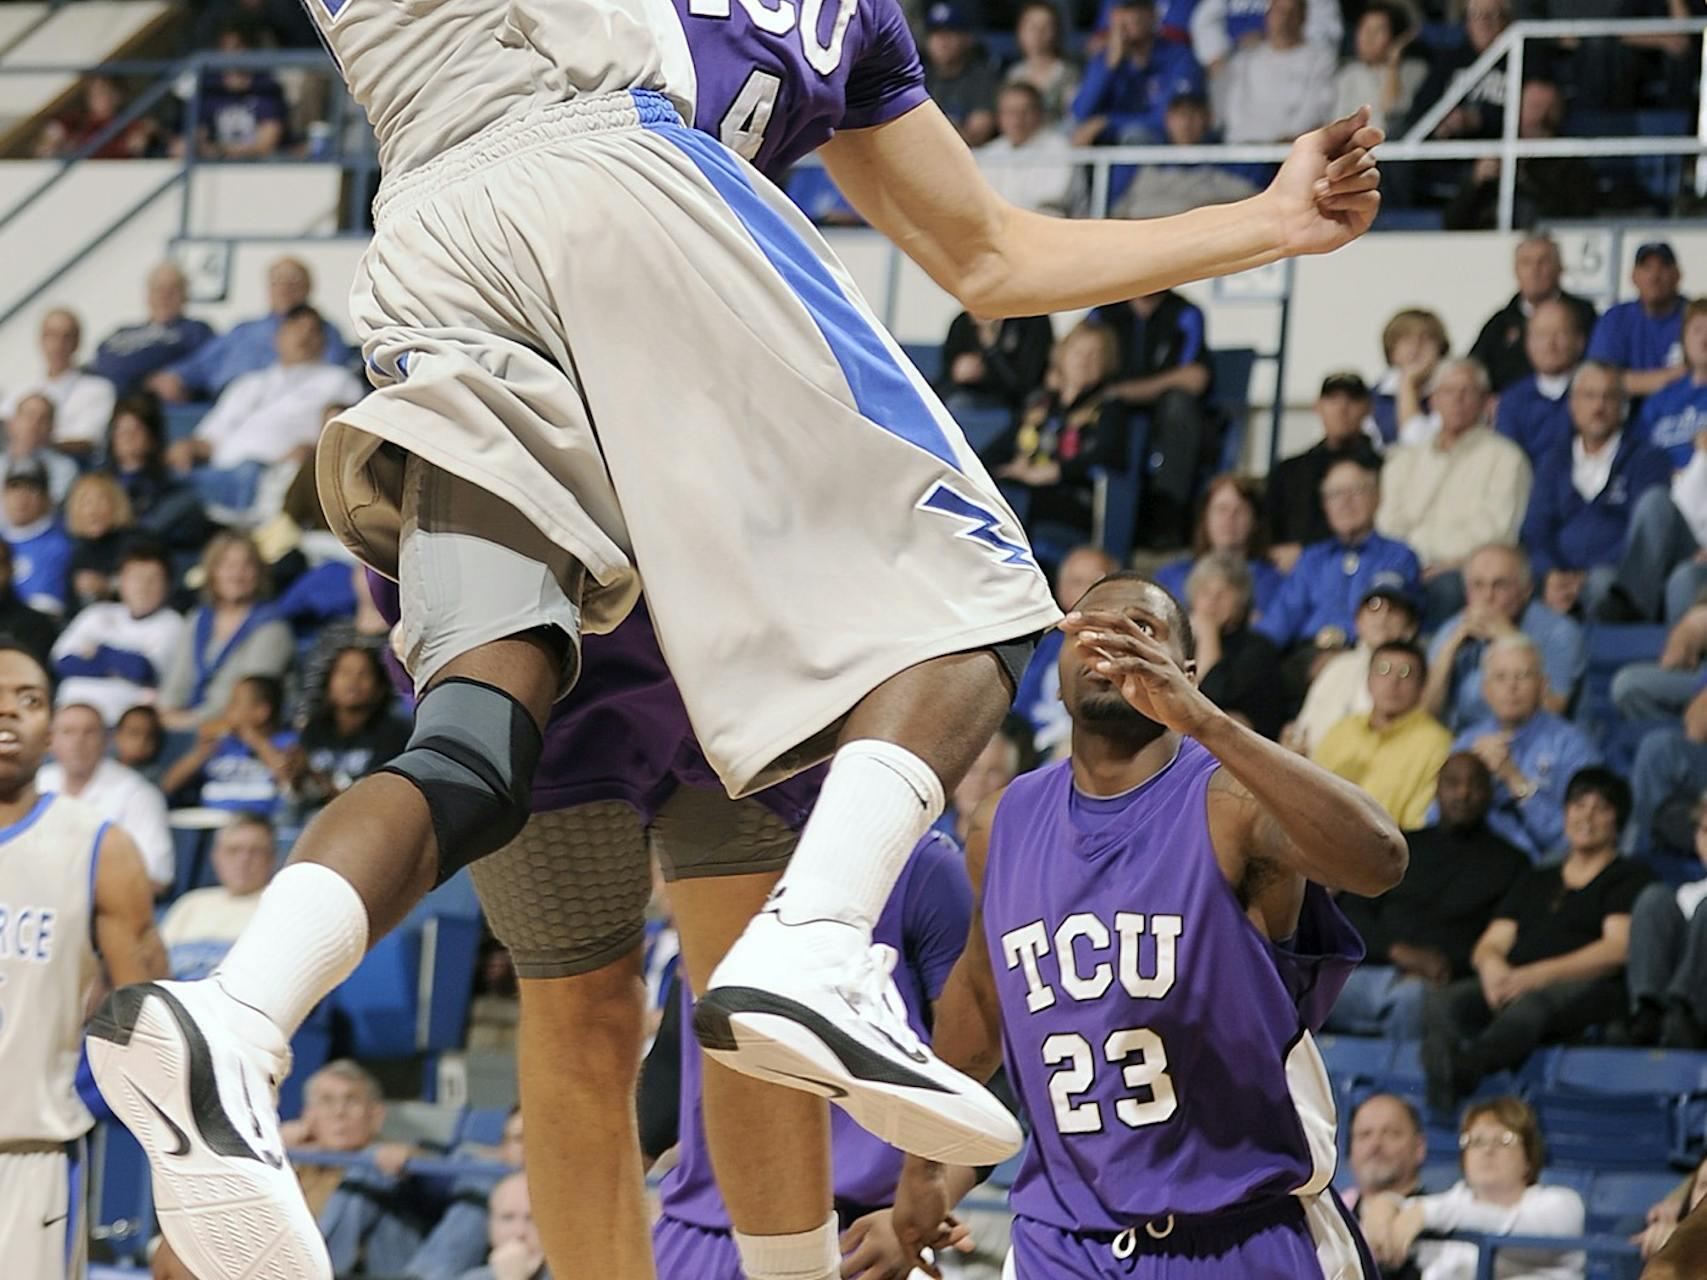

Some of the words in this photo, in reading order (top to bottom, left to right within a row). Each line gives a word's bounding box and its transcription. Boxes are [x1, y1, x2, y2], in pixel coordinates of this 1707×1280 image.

[720, 68, 783, 164] 4
[1000, 911, 1184, 1015] TCU
[1041, 1027, 1178, 1135] 23
